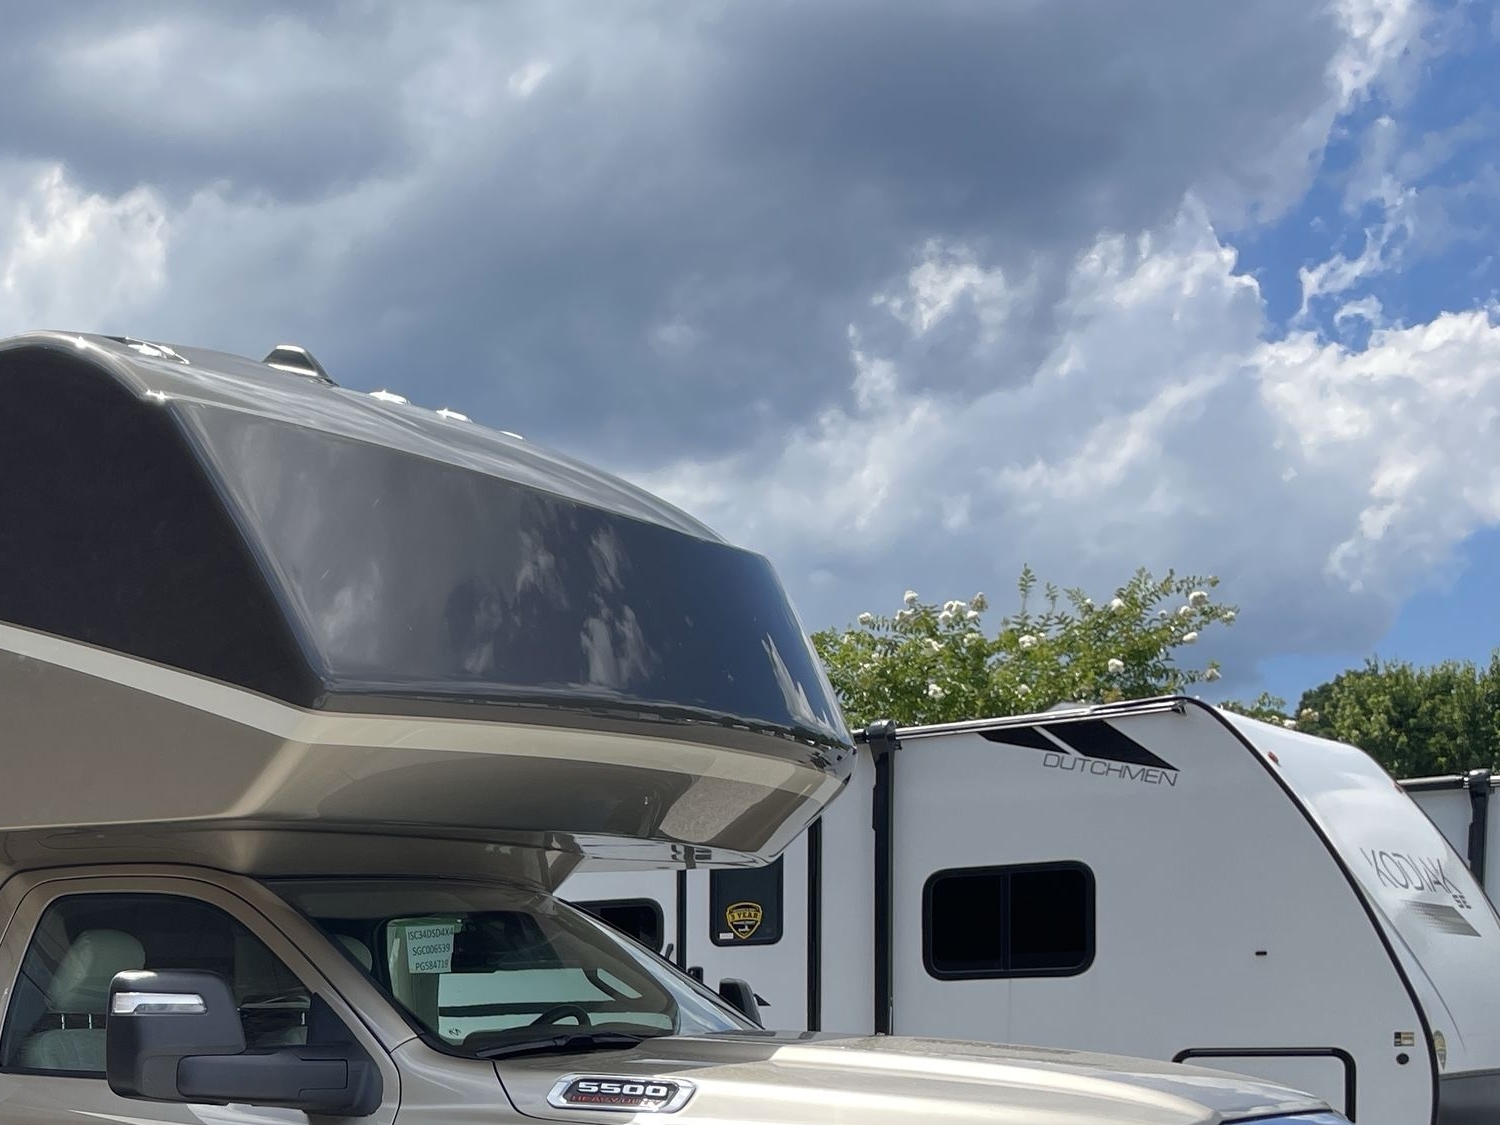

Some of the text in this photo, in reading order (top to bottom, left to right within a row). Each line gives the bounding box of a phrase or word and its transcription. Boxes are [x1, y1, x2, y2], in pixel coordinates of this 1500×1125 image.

[1043, 753, 1178, 787] DUTCHMEN
[1358, 847, 1463, 895] KODIAK
[578, 1081, 668, 1097] 5500
